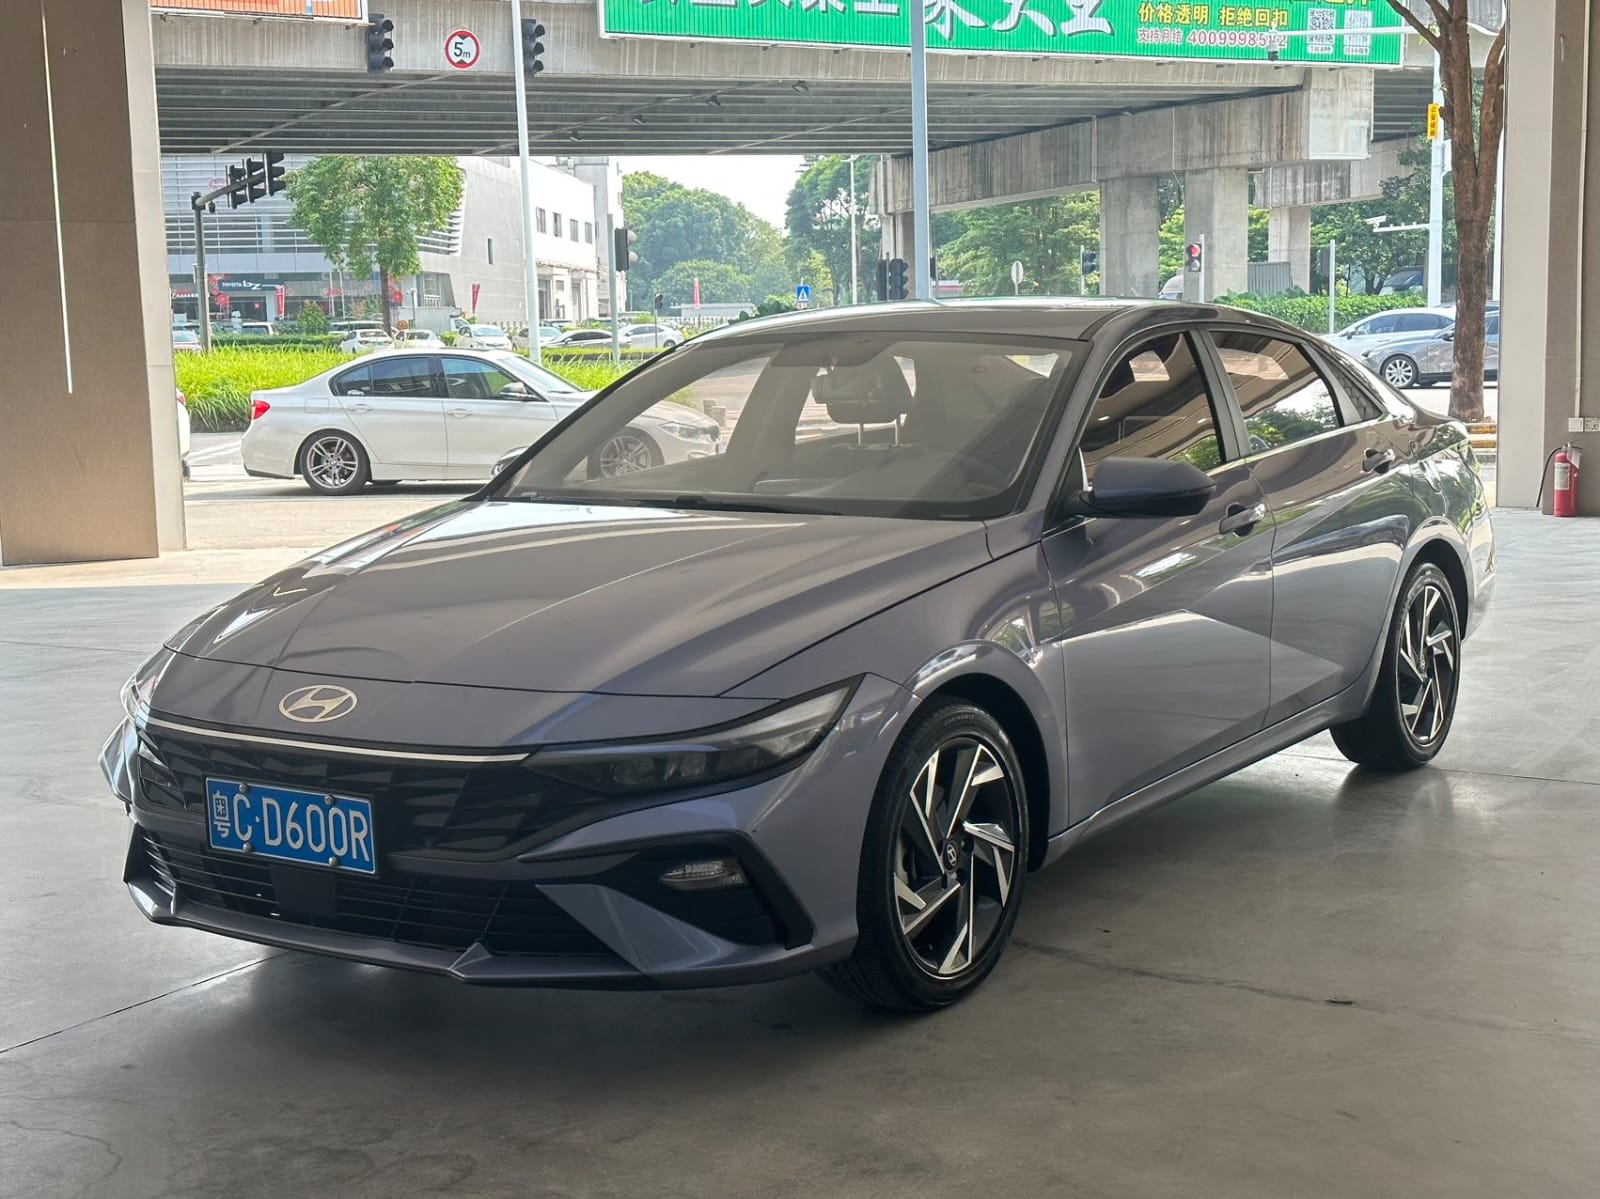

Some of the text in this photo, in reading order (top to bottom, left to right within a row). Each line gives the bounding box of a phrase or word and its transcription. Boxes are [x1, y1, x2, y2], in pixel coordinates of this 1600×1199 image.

[1138, 3, 1209, 25] 价格透明
[1219, 6, 1288, 27] 拒绝回扣
[1138, 28, 1183, 43] 支持月结
[454, 41, 470, 58] 5m
